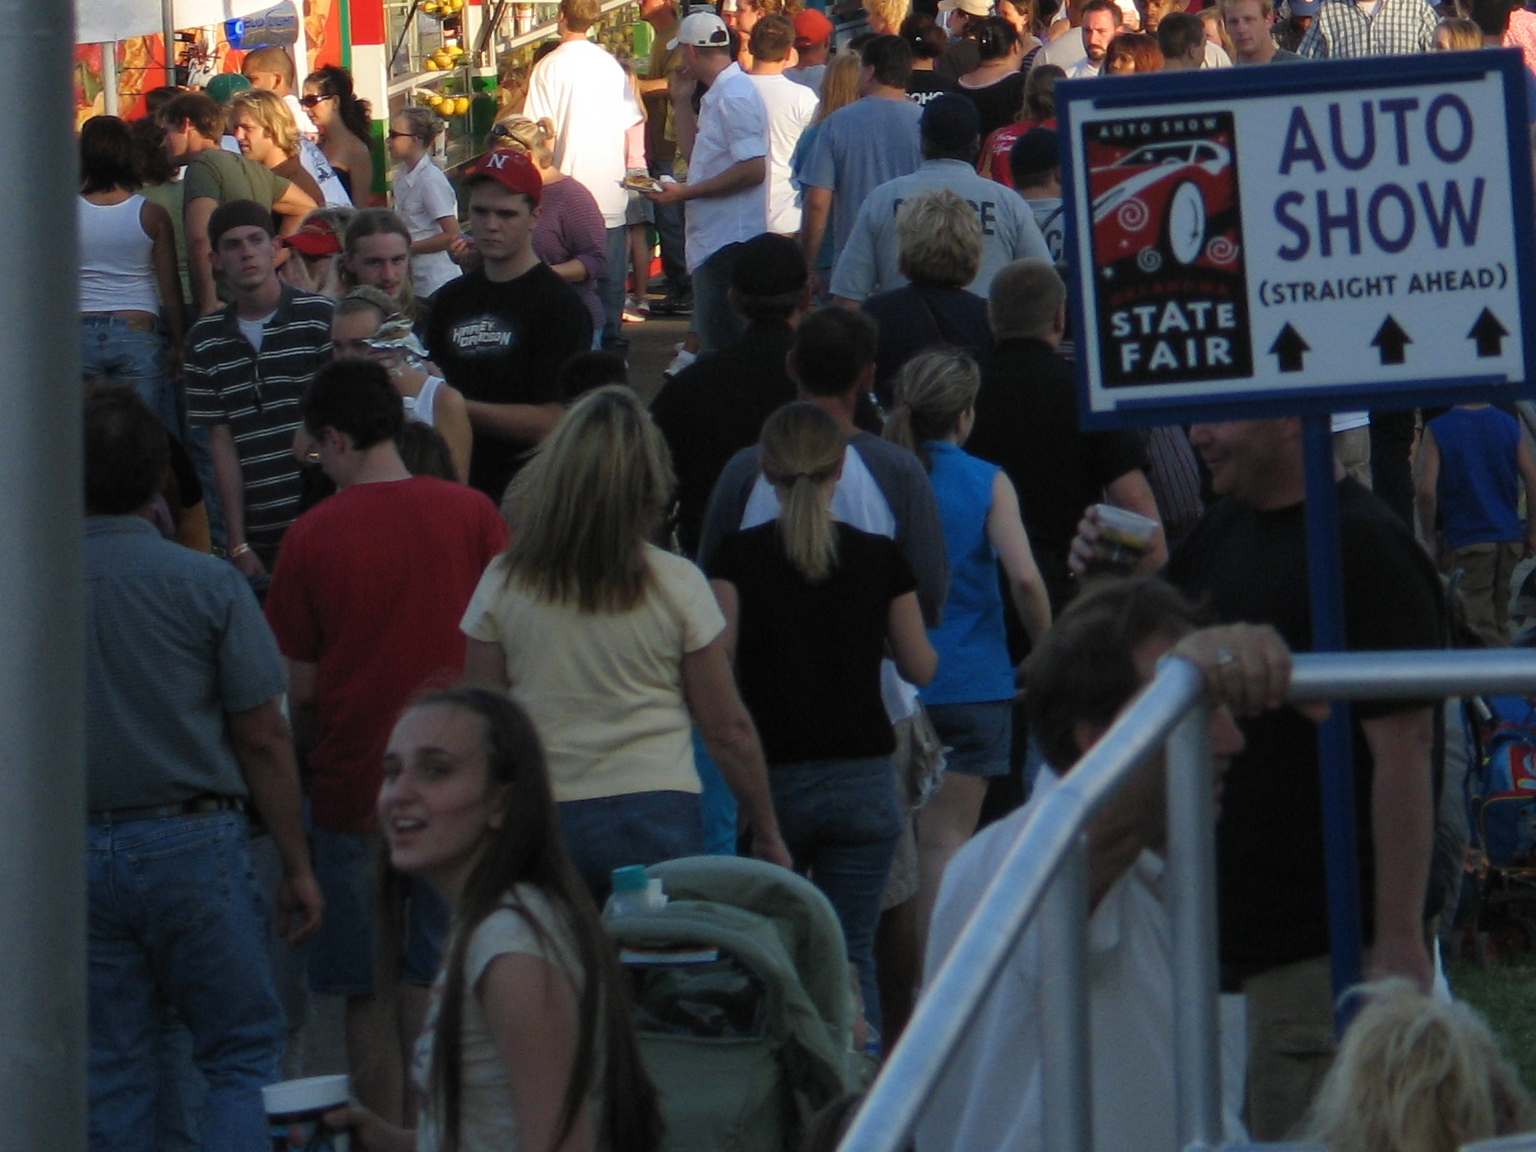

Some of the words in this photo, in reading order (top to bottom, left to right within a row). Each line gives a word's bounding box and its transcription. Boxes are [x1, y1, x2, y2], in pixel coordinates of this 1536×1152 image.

[1100, 122, 1151, 139] AUTO
[1160, 117, 1219, 134] SHOW
[1278, 92, 1475, 176] AUTO
[487, 154, 509, 170] N
[1273, 176, 1487, 262] SHOW
[1259, 274, 1398, 308] (STRAIGHT
[1408, 262, 1508, 297] AHEAD)
[1110, 300, 1236, 339] STATE
[1120, 336, 1234, 373] FAIR
